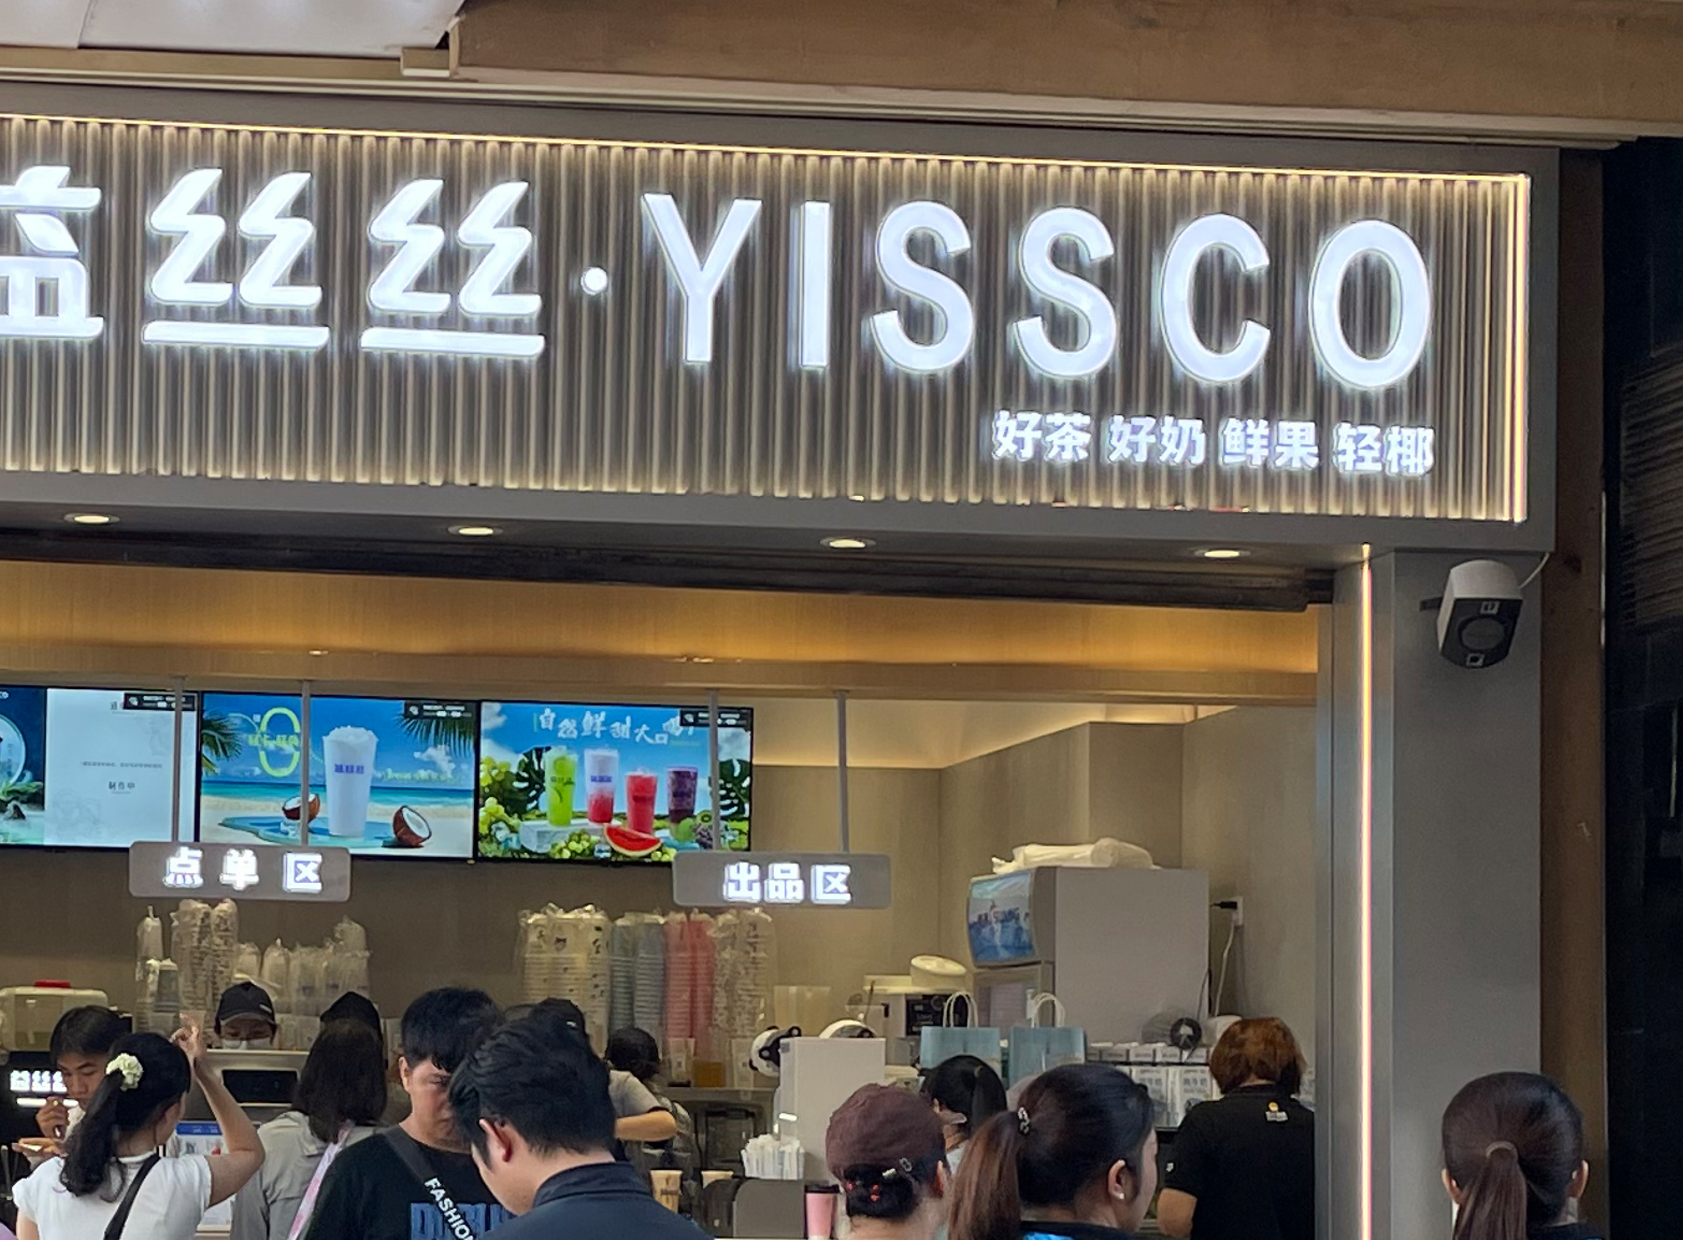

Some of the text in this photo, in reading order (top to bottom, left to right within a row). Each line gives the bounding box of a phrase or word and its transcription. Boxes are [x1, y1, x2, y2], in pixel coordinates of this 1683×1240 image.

[992, 410, 1435, 476] 好茶 好奶 鲜果 轻椰
[163, 846, 322, 893] 点单区
[723, 861, 852, 904] 出品区
